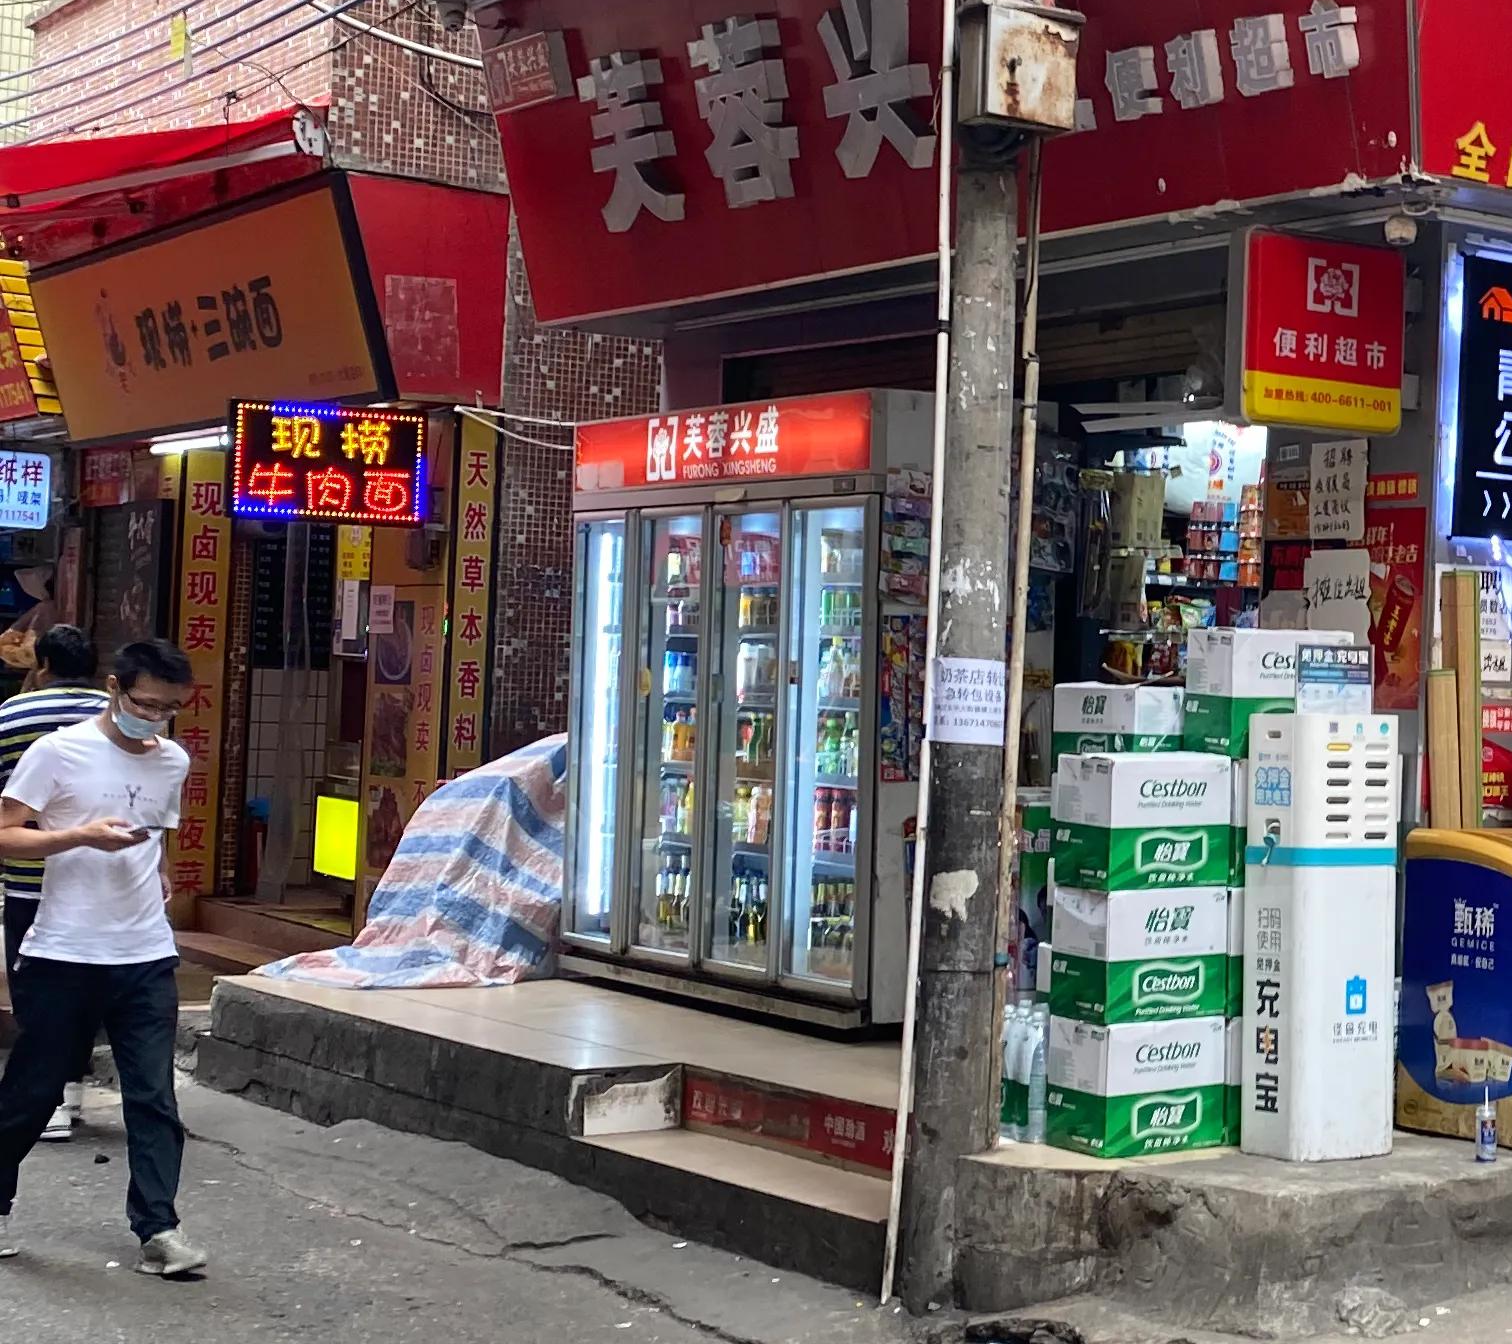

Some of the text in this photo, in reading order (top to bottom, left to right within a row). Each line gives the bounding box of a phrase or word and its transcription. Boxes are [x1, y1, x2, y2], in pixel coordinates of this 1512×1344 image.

[1273, 326, 1388, 370] 便利超市
[271, 414, 392, 466] 现捞
[683, 405, 780, 460] 芙蓉兴盛
[248, 462, 411, 513] 牛肉面
[682, 457, 776, 481] FURONG XINGSHENG
[1256, 930, 1282, 952] 使用
[1257, 908, 1282, 929] 扫码
[1255, 978, 1281, 1114] 充电宝
